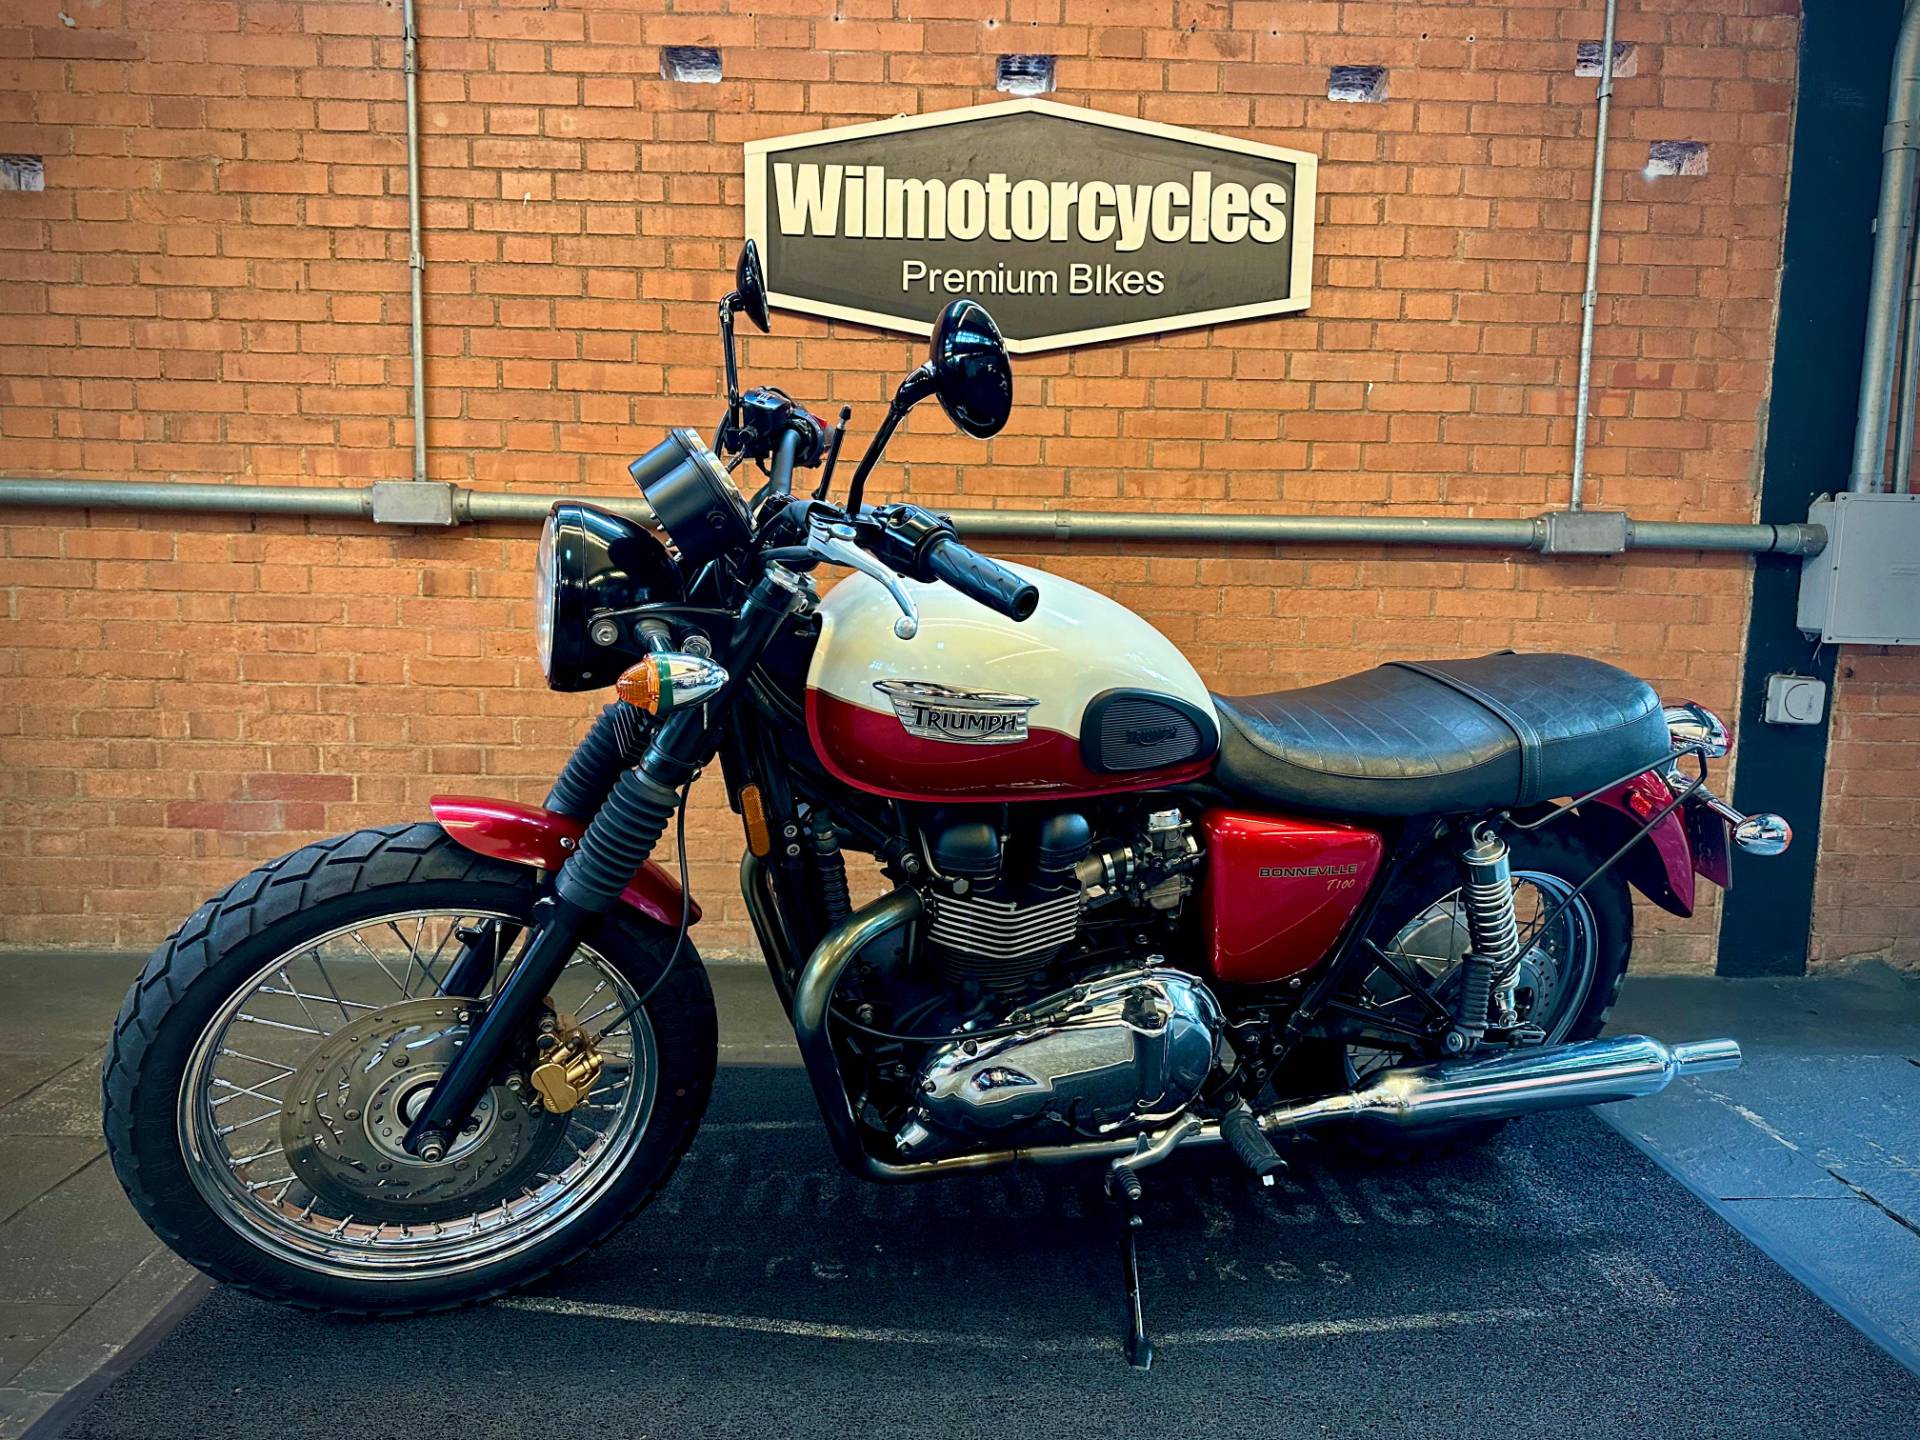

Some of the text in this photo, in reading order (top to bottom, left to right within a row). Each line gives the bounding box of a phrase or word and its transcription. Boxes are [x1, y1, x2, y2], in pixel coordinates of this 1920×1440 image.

[773, 162, 1287, 251] Wilmotorcycles
[902, 260, 1058, 294] Premium
[912, 704, 1017, 738] TRIUMPH
[1258, 864, 1358, 878] BONNEVILLE
[1327, 879, 1356, 891] T100
